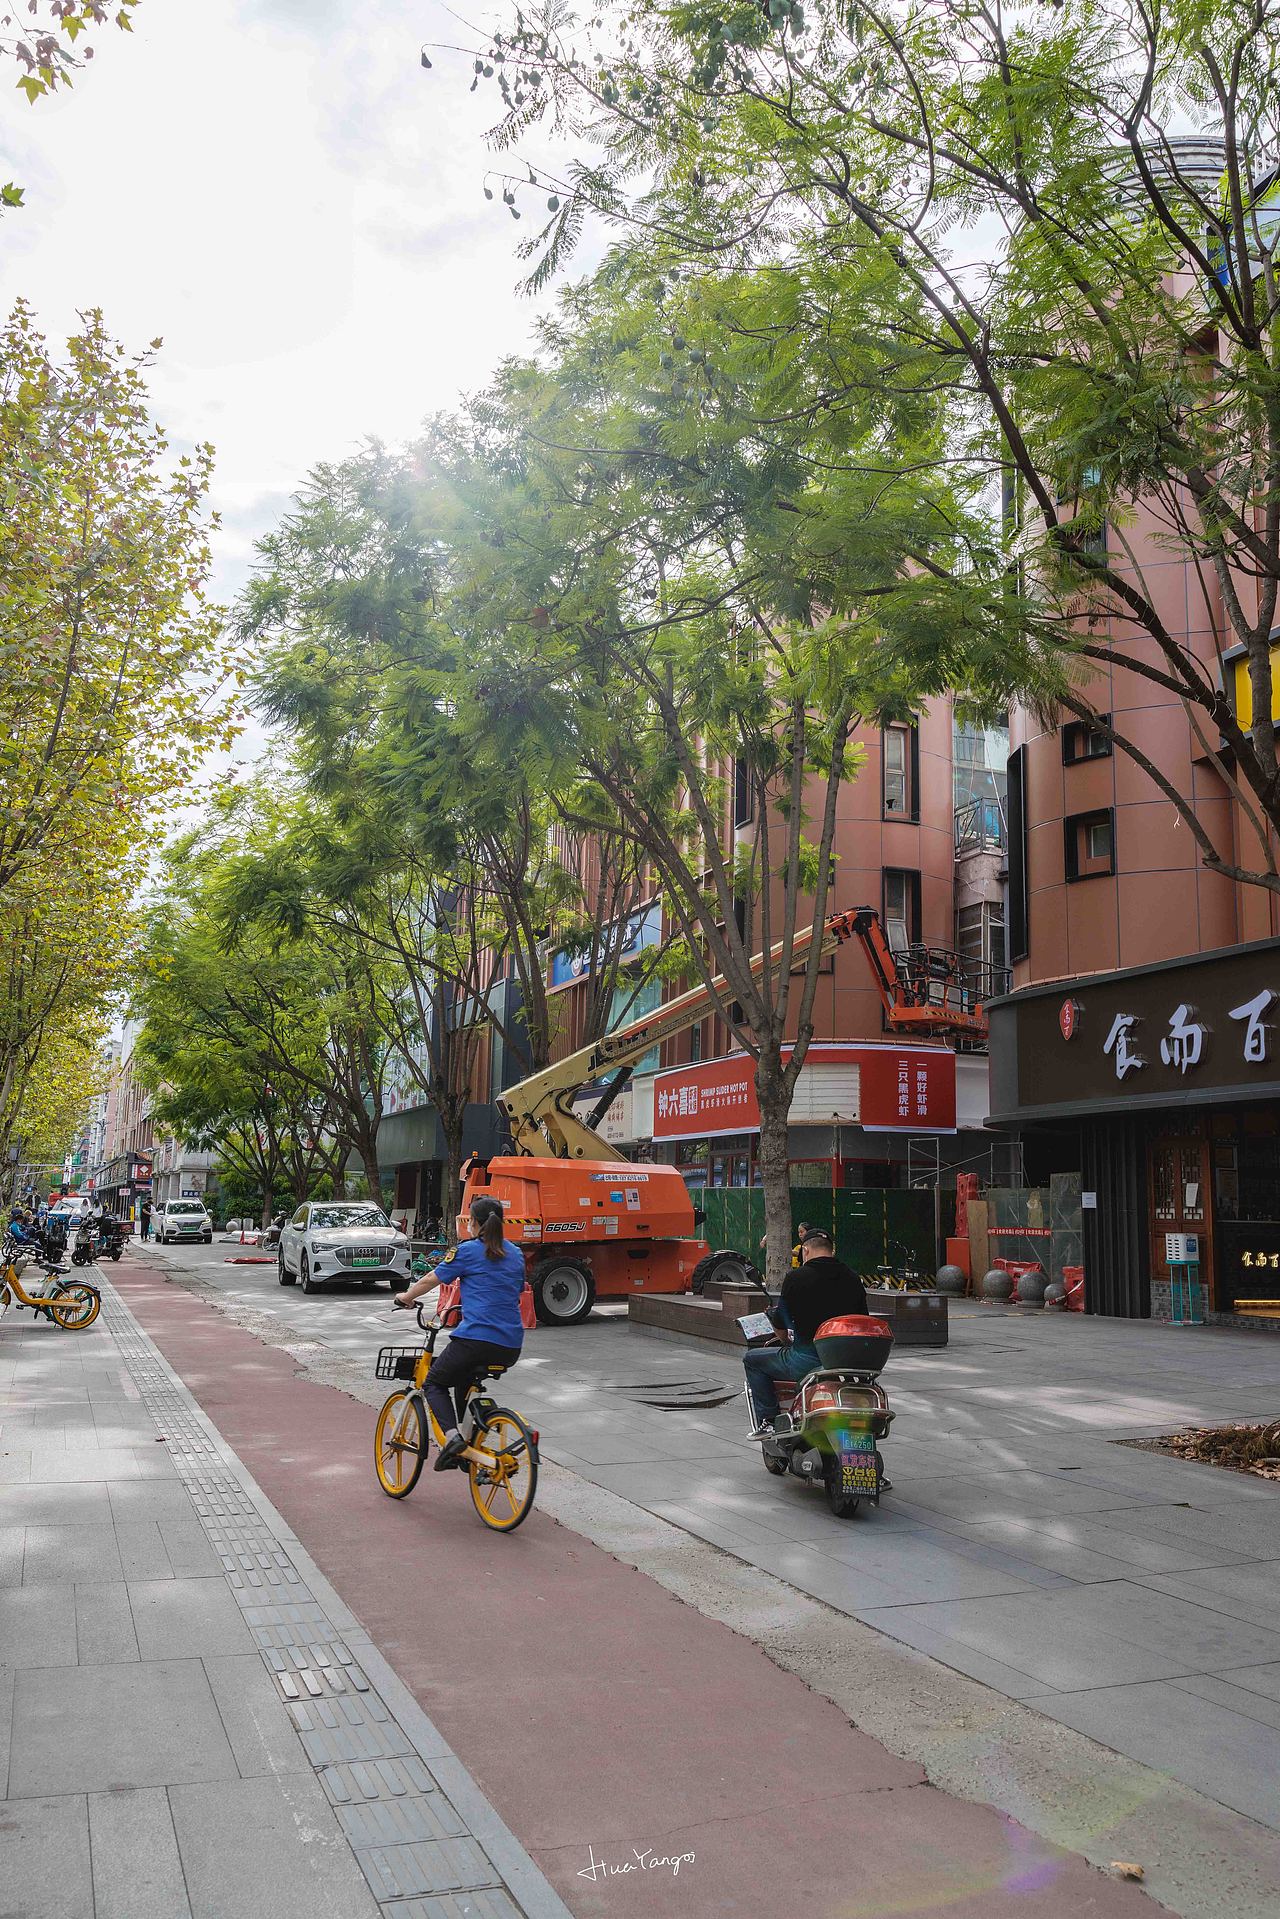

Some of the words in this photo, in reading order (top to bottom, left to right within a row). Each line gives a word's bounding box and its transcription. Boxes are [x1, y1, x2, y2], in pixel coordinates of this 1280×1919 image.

[1103, 989, 1272, 1080] 食而百
[730, 1083, 739, 1093] HOT
[739, 1081, 748, 1092] POT
[898, 1060, 909, 1116] 三只黑虎虾
[917, 1063, 928, 1115] 一颗好虾滑
[545, 1221, 586, 1232] 660SJ
